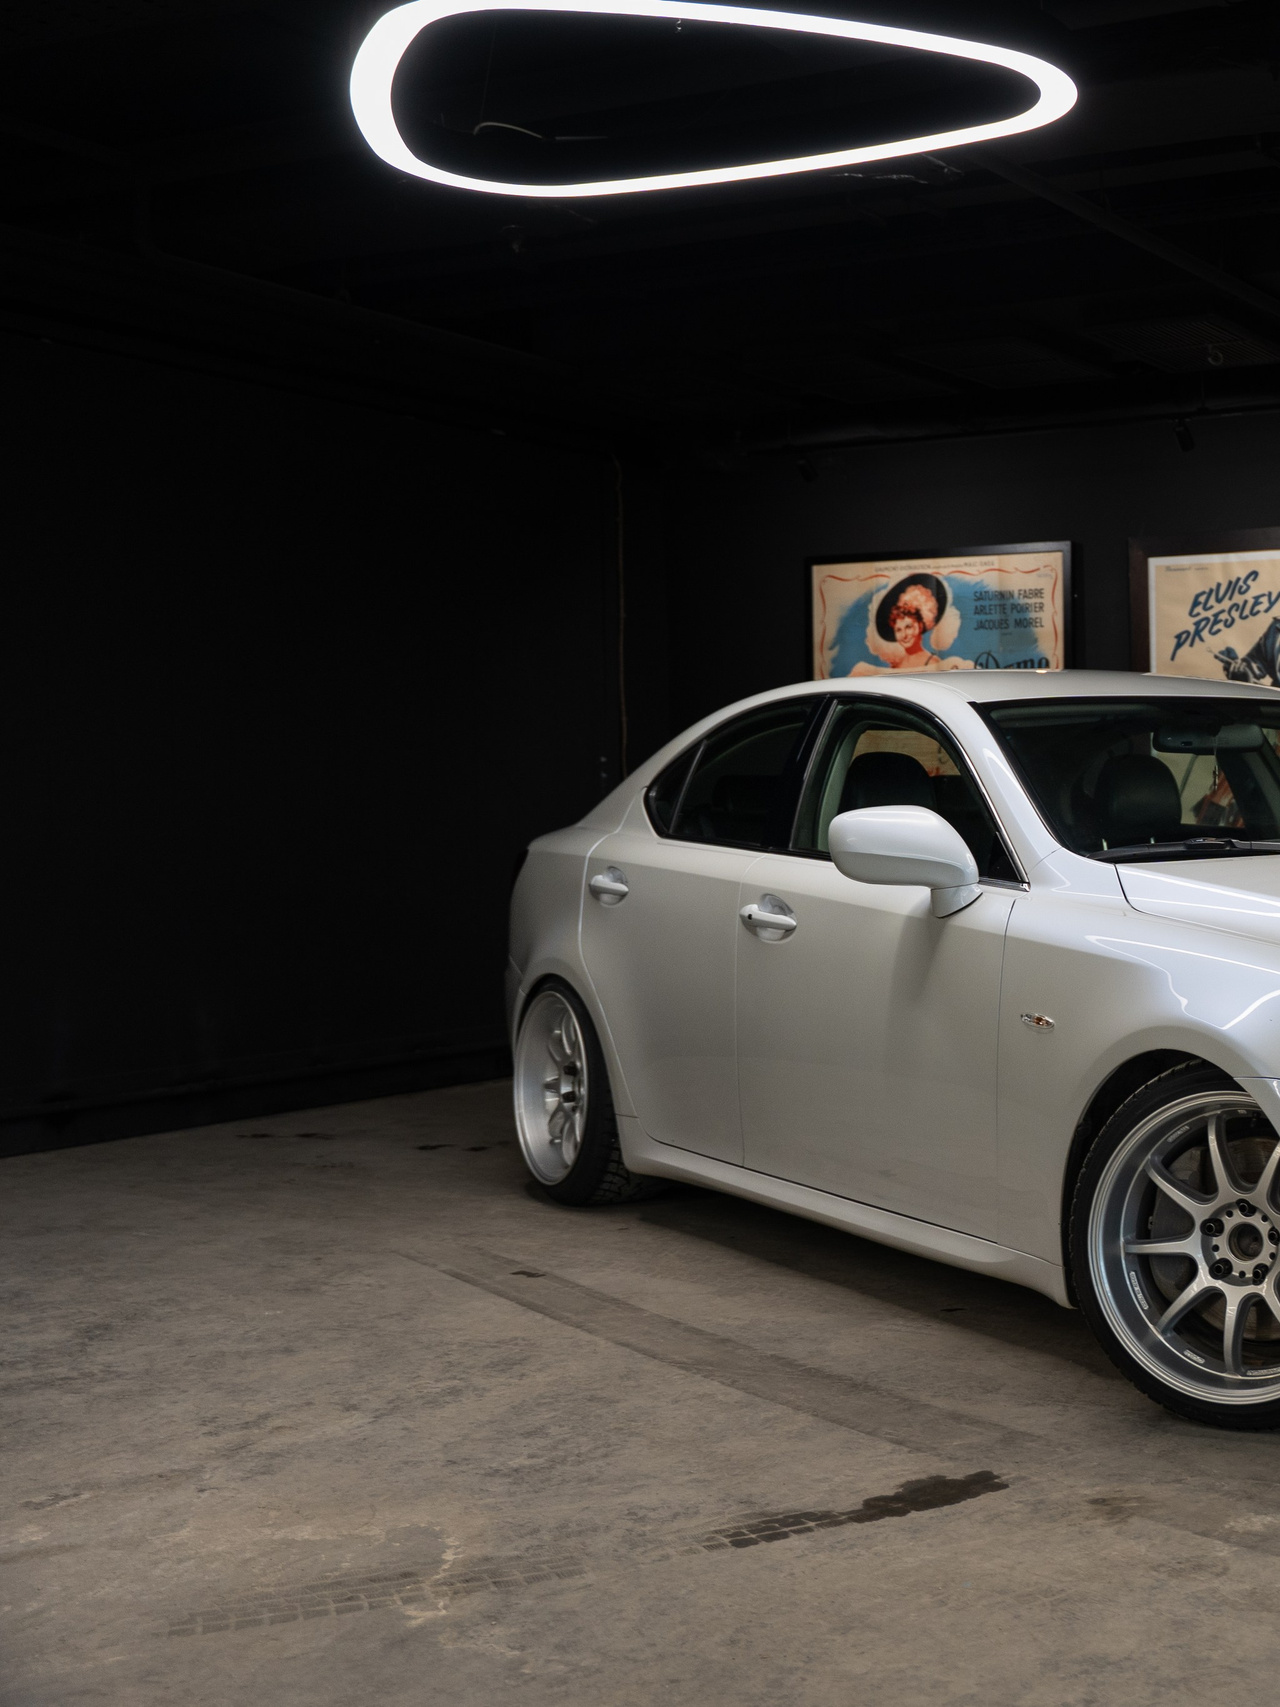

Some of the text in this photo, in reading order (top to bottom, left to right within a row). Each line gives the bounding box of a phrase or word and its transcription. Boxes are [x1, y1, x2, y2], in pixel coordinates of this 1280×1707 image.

[973, 588, 1045, 602] SATURNIN FABRE
[1188, 570, 1259, 618] ELVIS
[973, 602, 1045, 615] ARLETTE POIRIER
[973, 617, 1045, 631] JACQUES MOREL
